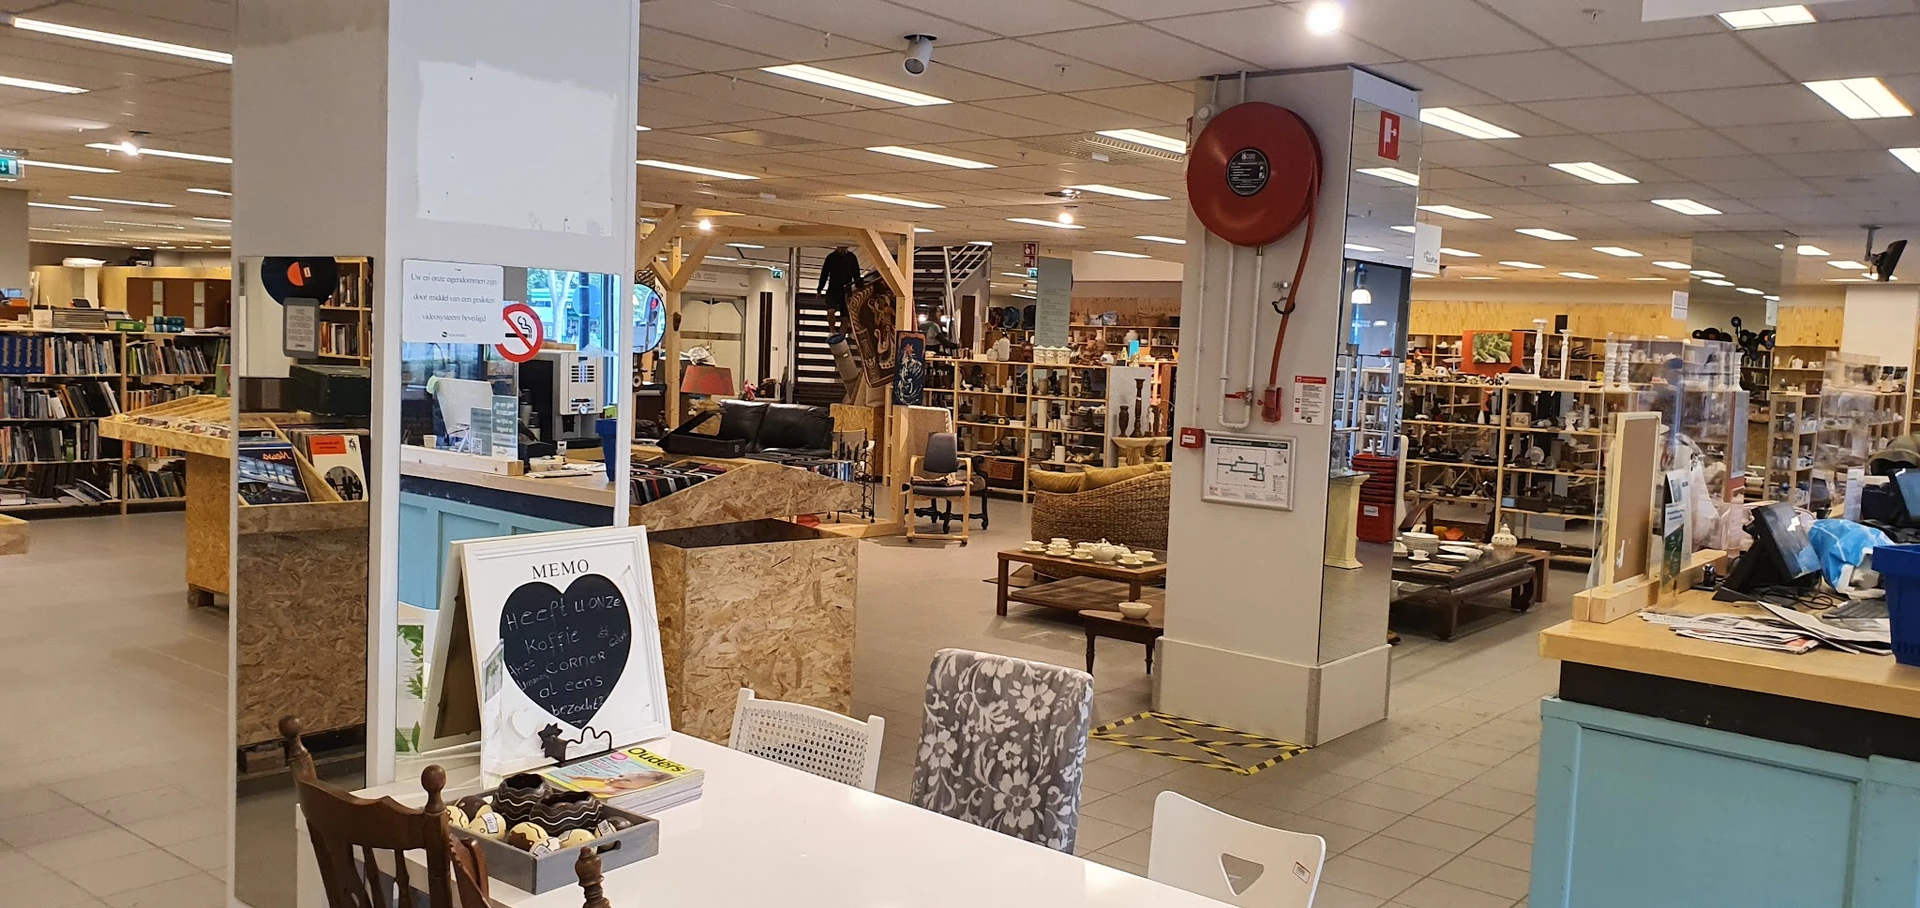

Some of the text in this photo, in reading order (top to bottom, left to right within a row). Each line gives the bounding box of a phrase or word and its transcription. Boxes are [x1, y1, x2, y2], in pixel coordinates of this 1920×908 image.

[411, 273, 421, 281] Uw
[446, 275, 485, 285] eigendommen
[486, 277, 498, 286] zijn
[413, 293, 427, 301] door
[429, 293, 449, 301] middel
[472, 296, 495, 304] gesloten
[422, 313, 487, 323] videosysteem beveiligd
[532, 559, 589, 579] MEMO
[628, 747, 685, 772] Ouders
